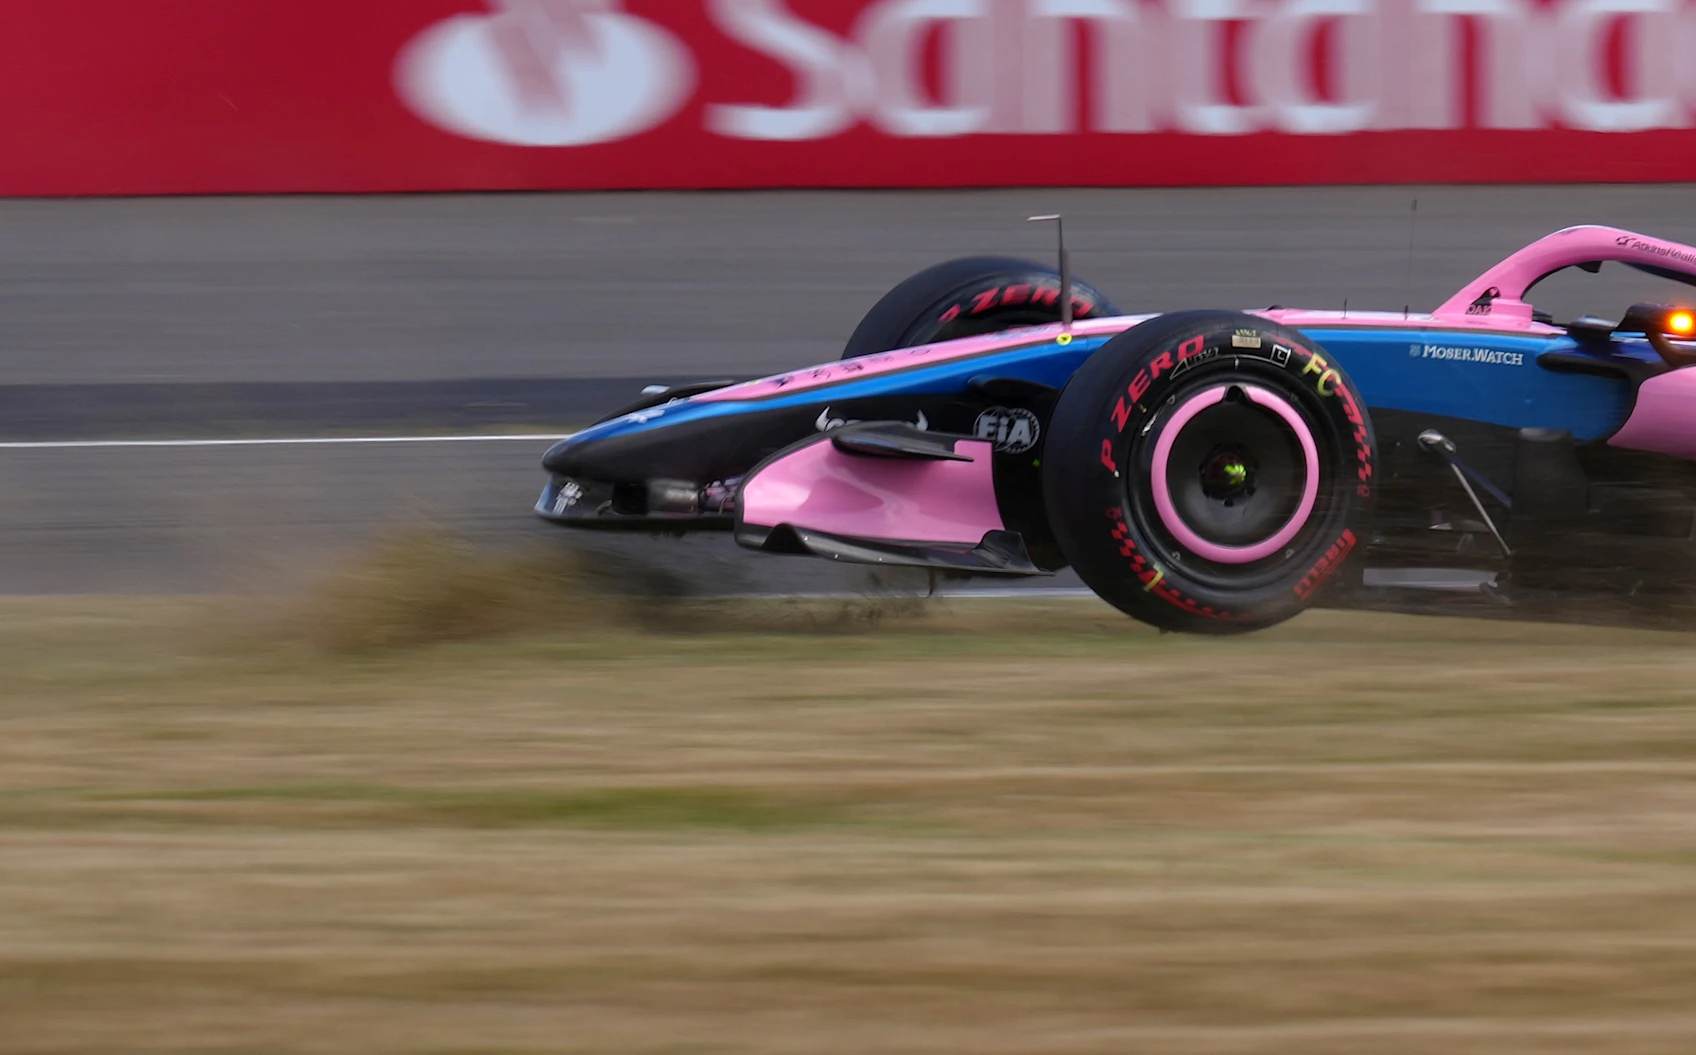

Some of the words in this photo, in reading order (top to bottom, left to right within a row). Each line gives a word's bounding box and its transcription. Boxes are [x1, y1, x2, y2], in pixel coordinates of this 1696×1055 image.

[1302, 352, 1342, 396] FC
[1422, 344, 1524, 366] MOSER.WATCH
[1101, 438, 1117, 473] P
[1111, 334, 1205, 434] ZERO
[1294, 528, 1357, 601] PIRELLI
